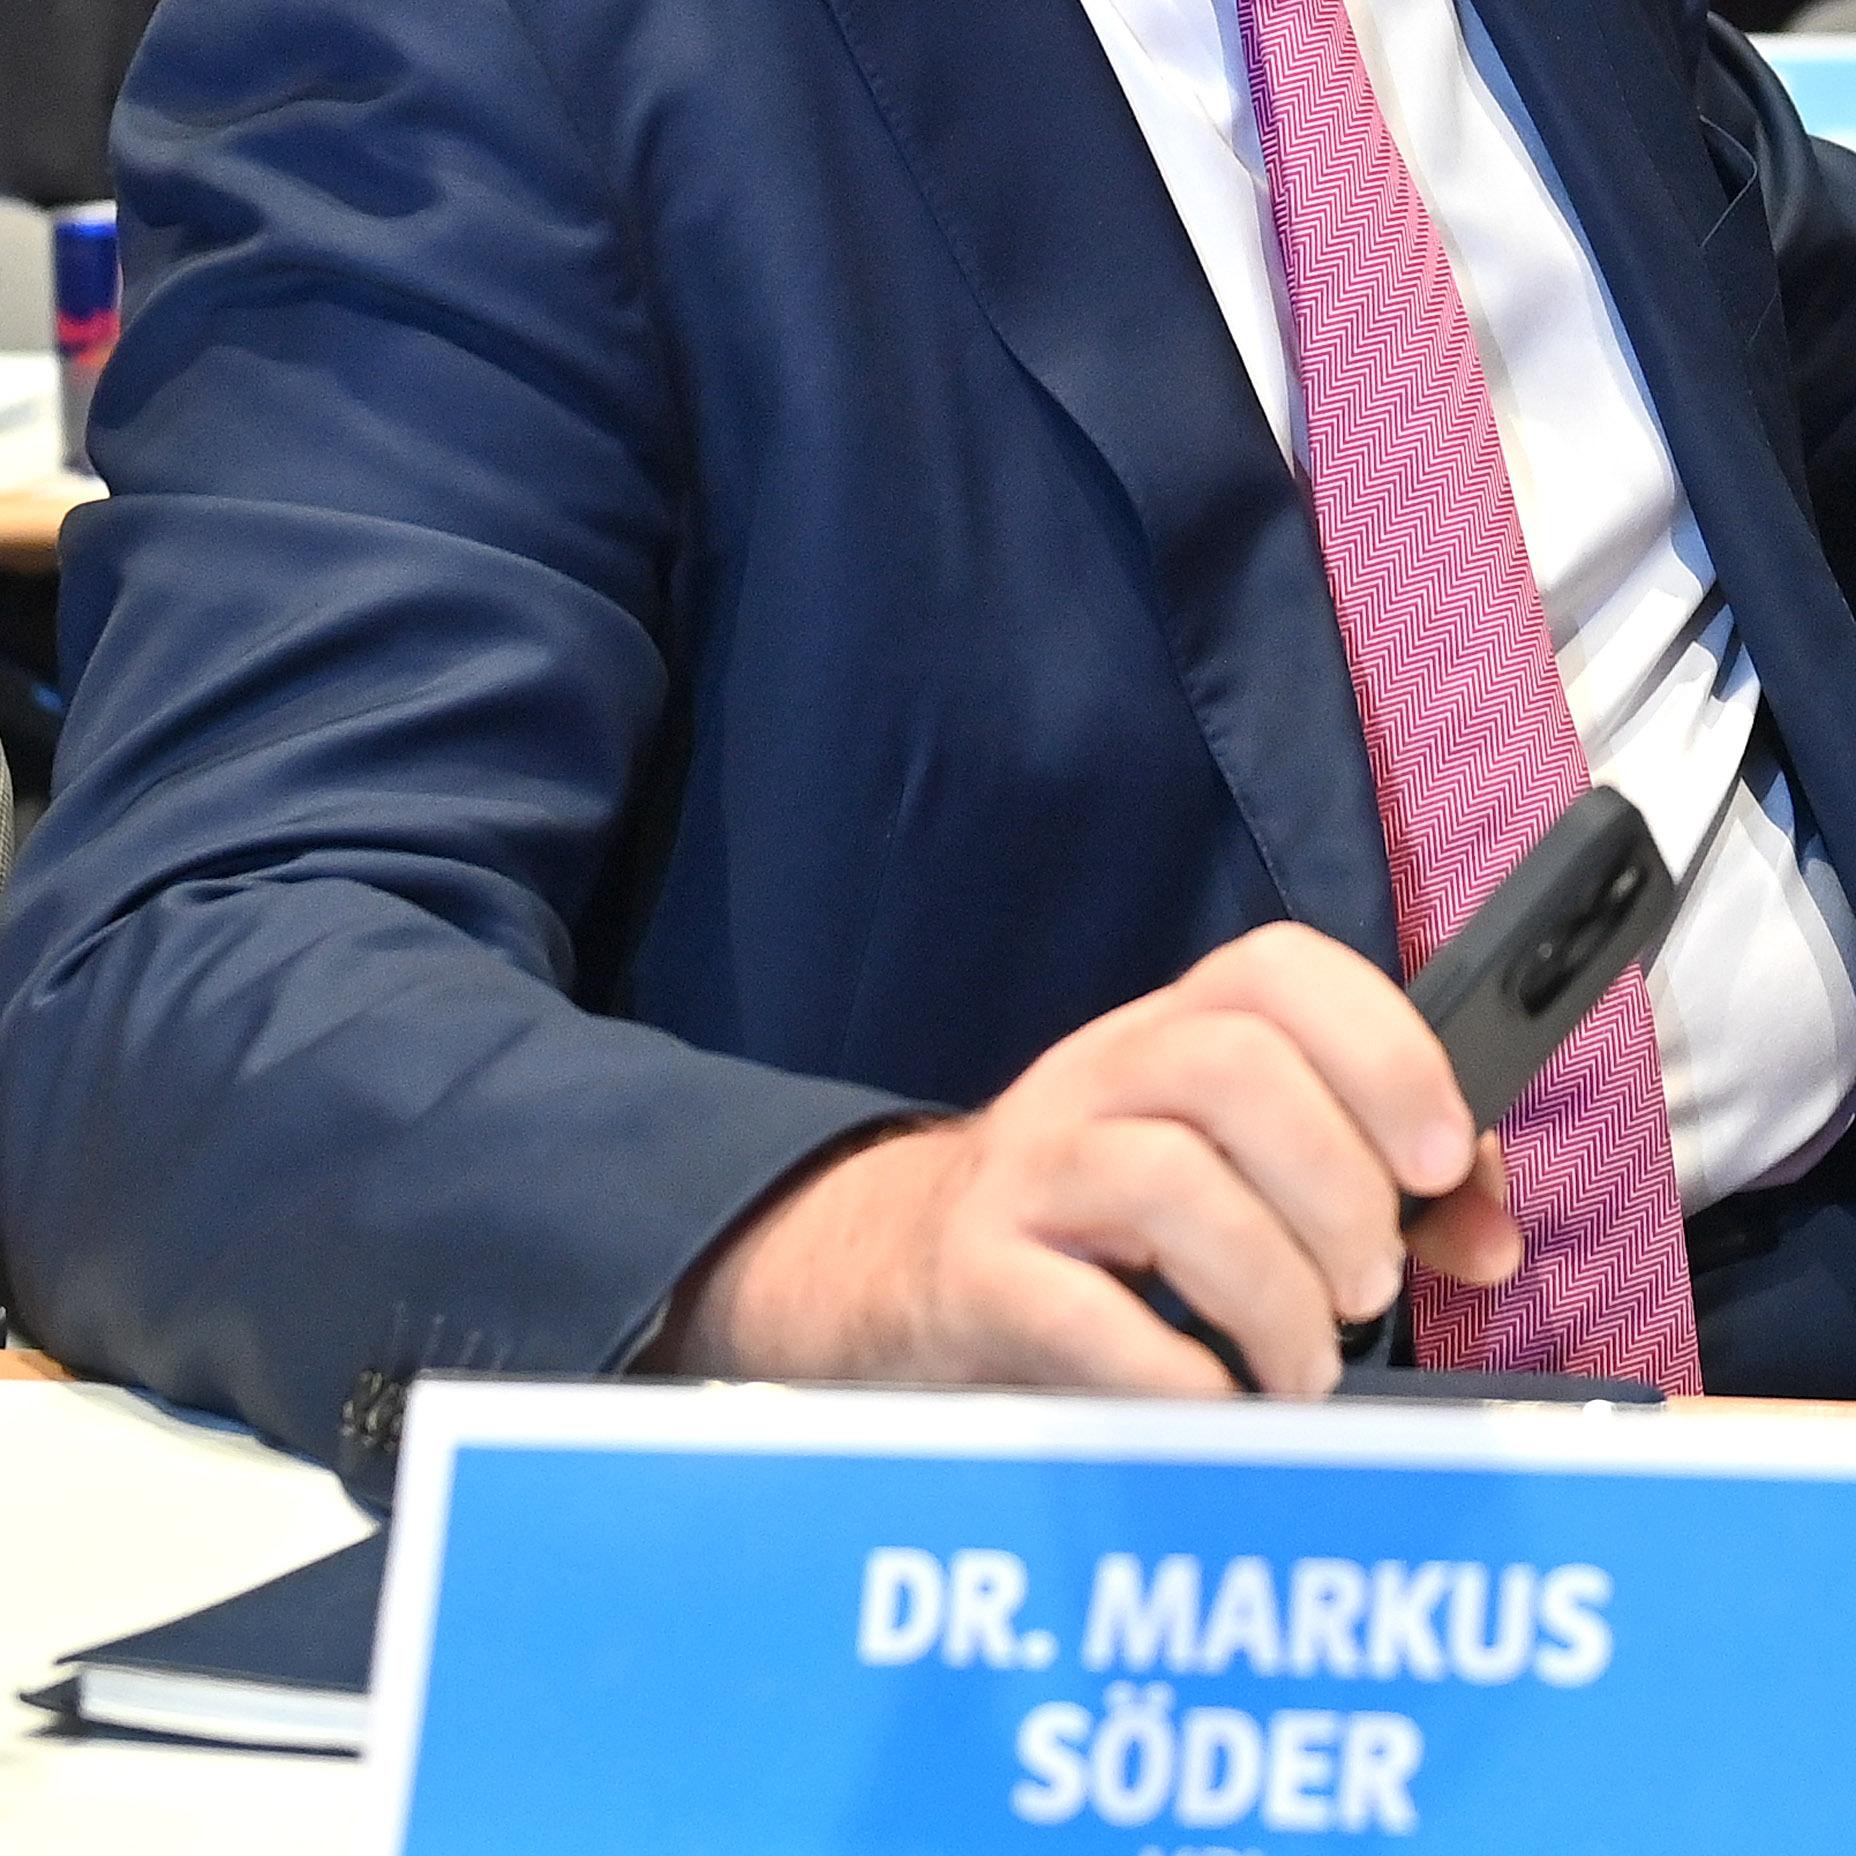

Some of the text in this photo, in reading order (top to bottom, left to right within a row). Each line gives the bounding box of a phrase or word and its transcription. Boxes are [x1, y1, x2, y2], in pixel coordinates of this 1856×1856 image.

[856, 1545, 1614, 1688] DR. MARKUS
[1010, 1679, 1425, 1837] SÖDER
